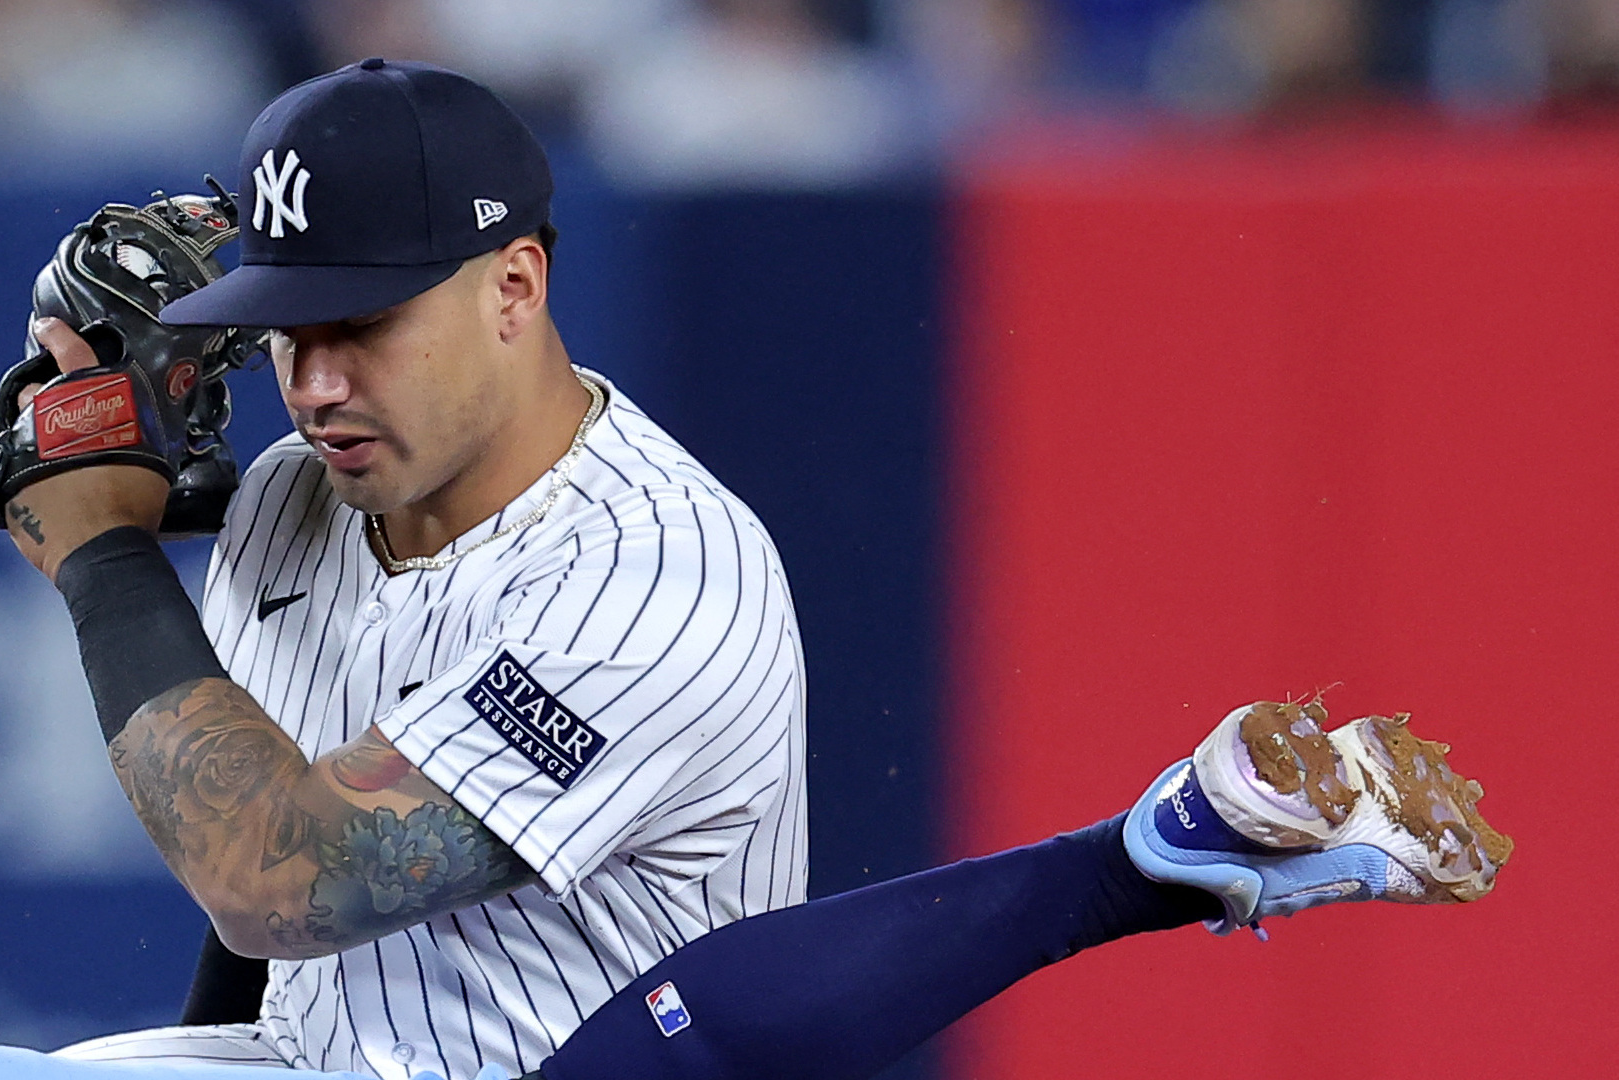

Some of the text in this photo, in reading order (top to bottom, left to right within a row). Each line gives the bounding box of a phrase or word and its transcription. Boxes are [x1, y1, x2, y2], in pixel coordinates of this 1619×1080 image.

[252, 149, 311, 238] NY
[45, 395, 125, 434] Rawlings
[473, 691, 570, 780] INSURANCE
[487, 660, 593, 764] STARR
